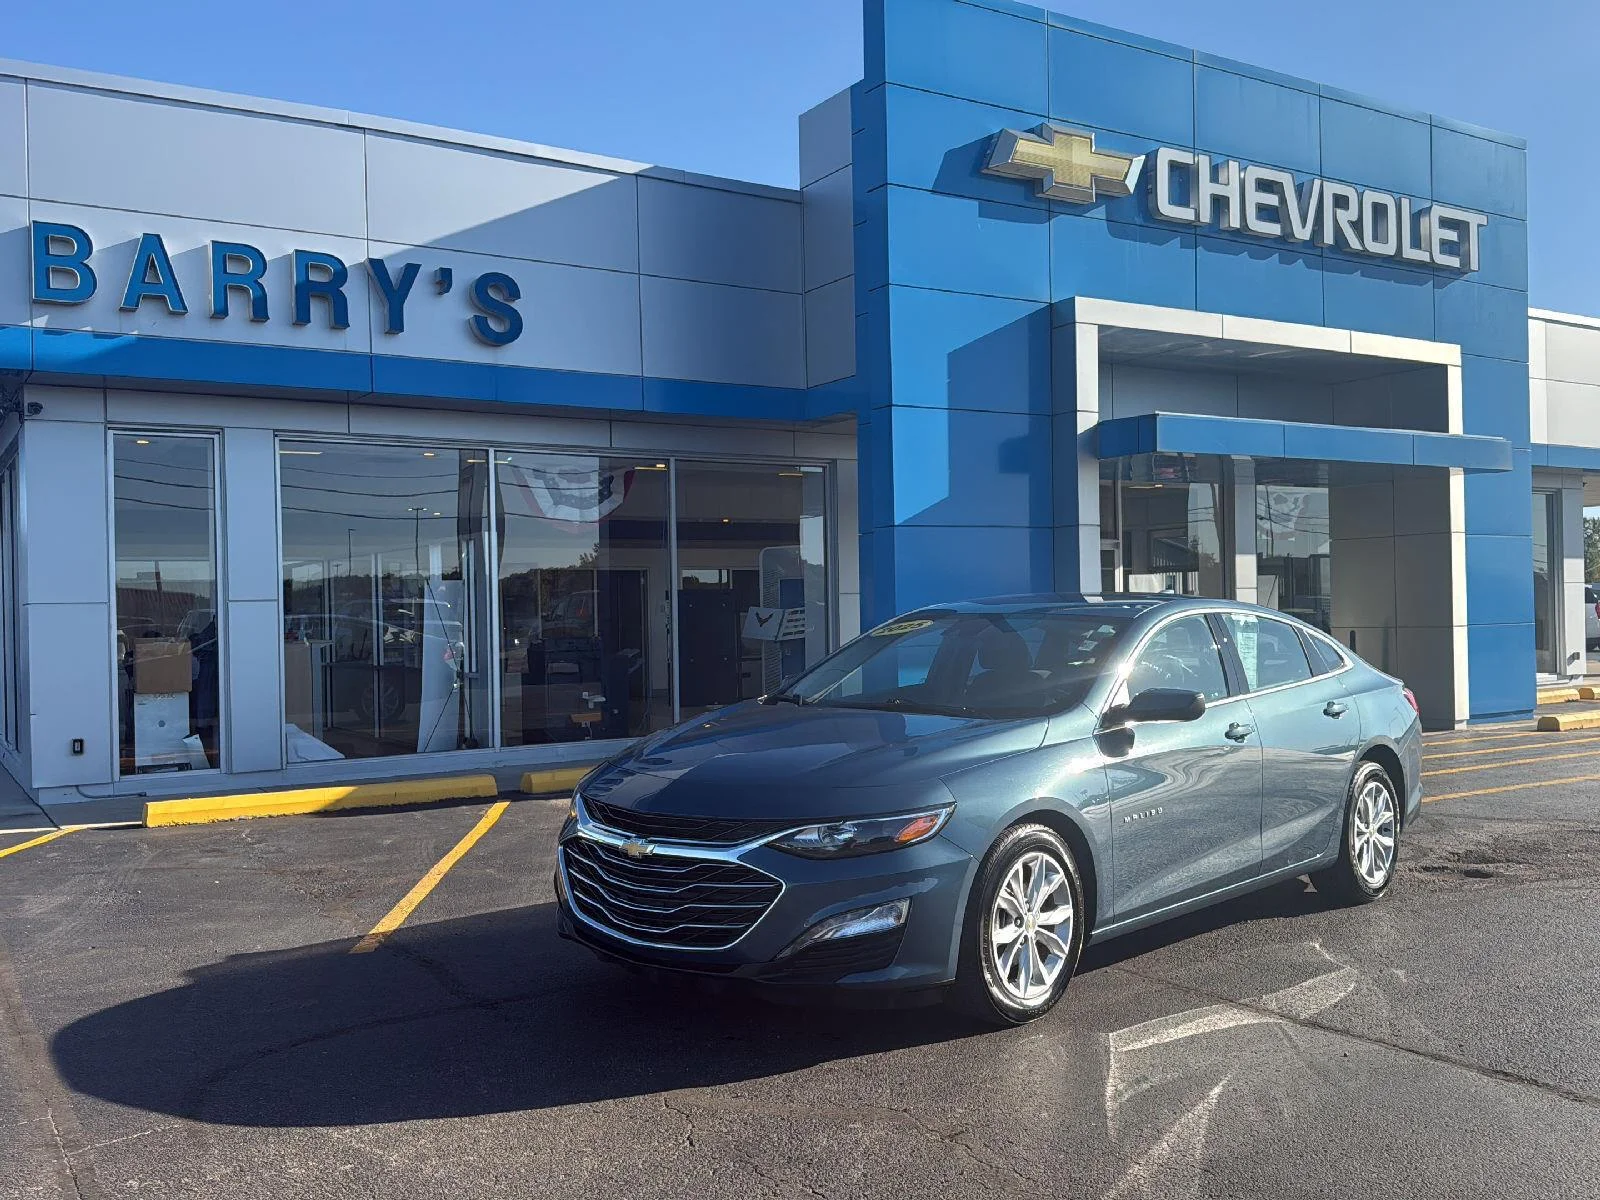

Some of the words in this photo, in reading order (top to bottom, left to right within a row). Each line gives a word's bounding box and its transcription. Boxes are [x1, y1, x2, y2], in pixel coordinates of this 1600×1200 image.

[1153, 146, 1488, 273] CHEVROLET
[31, 220, 523, 347] BARRY'S
[1124, 807, 1163, 823] MALIBU
